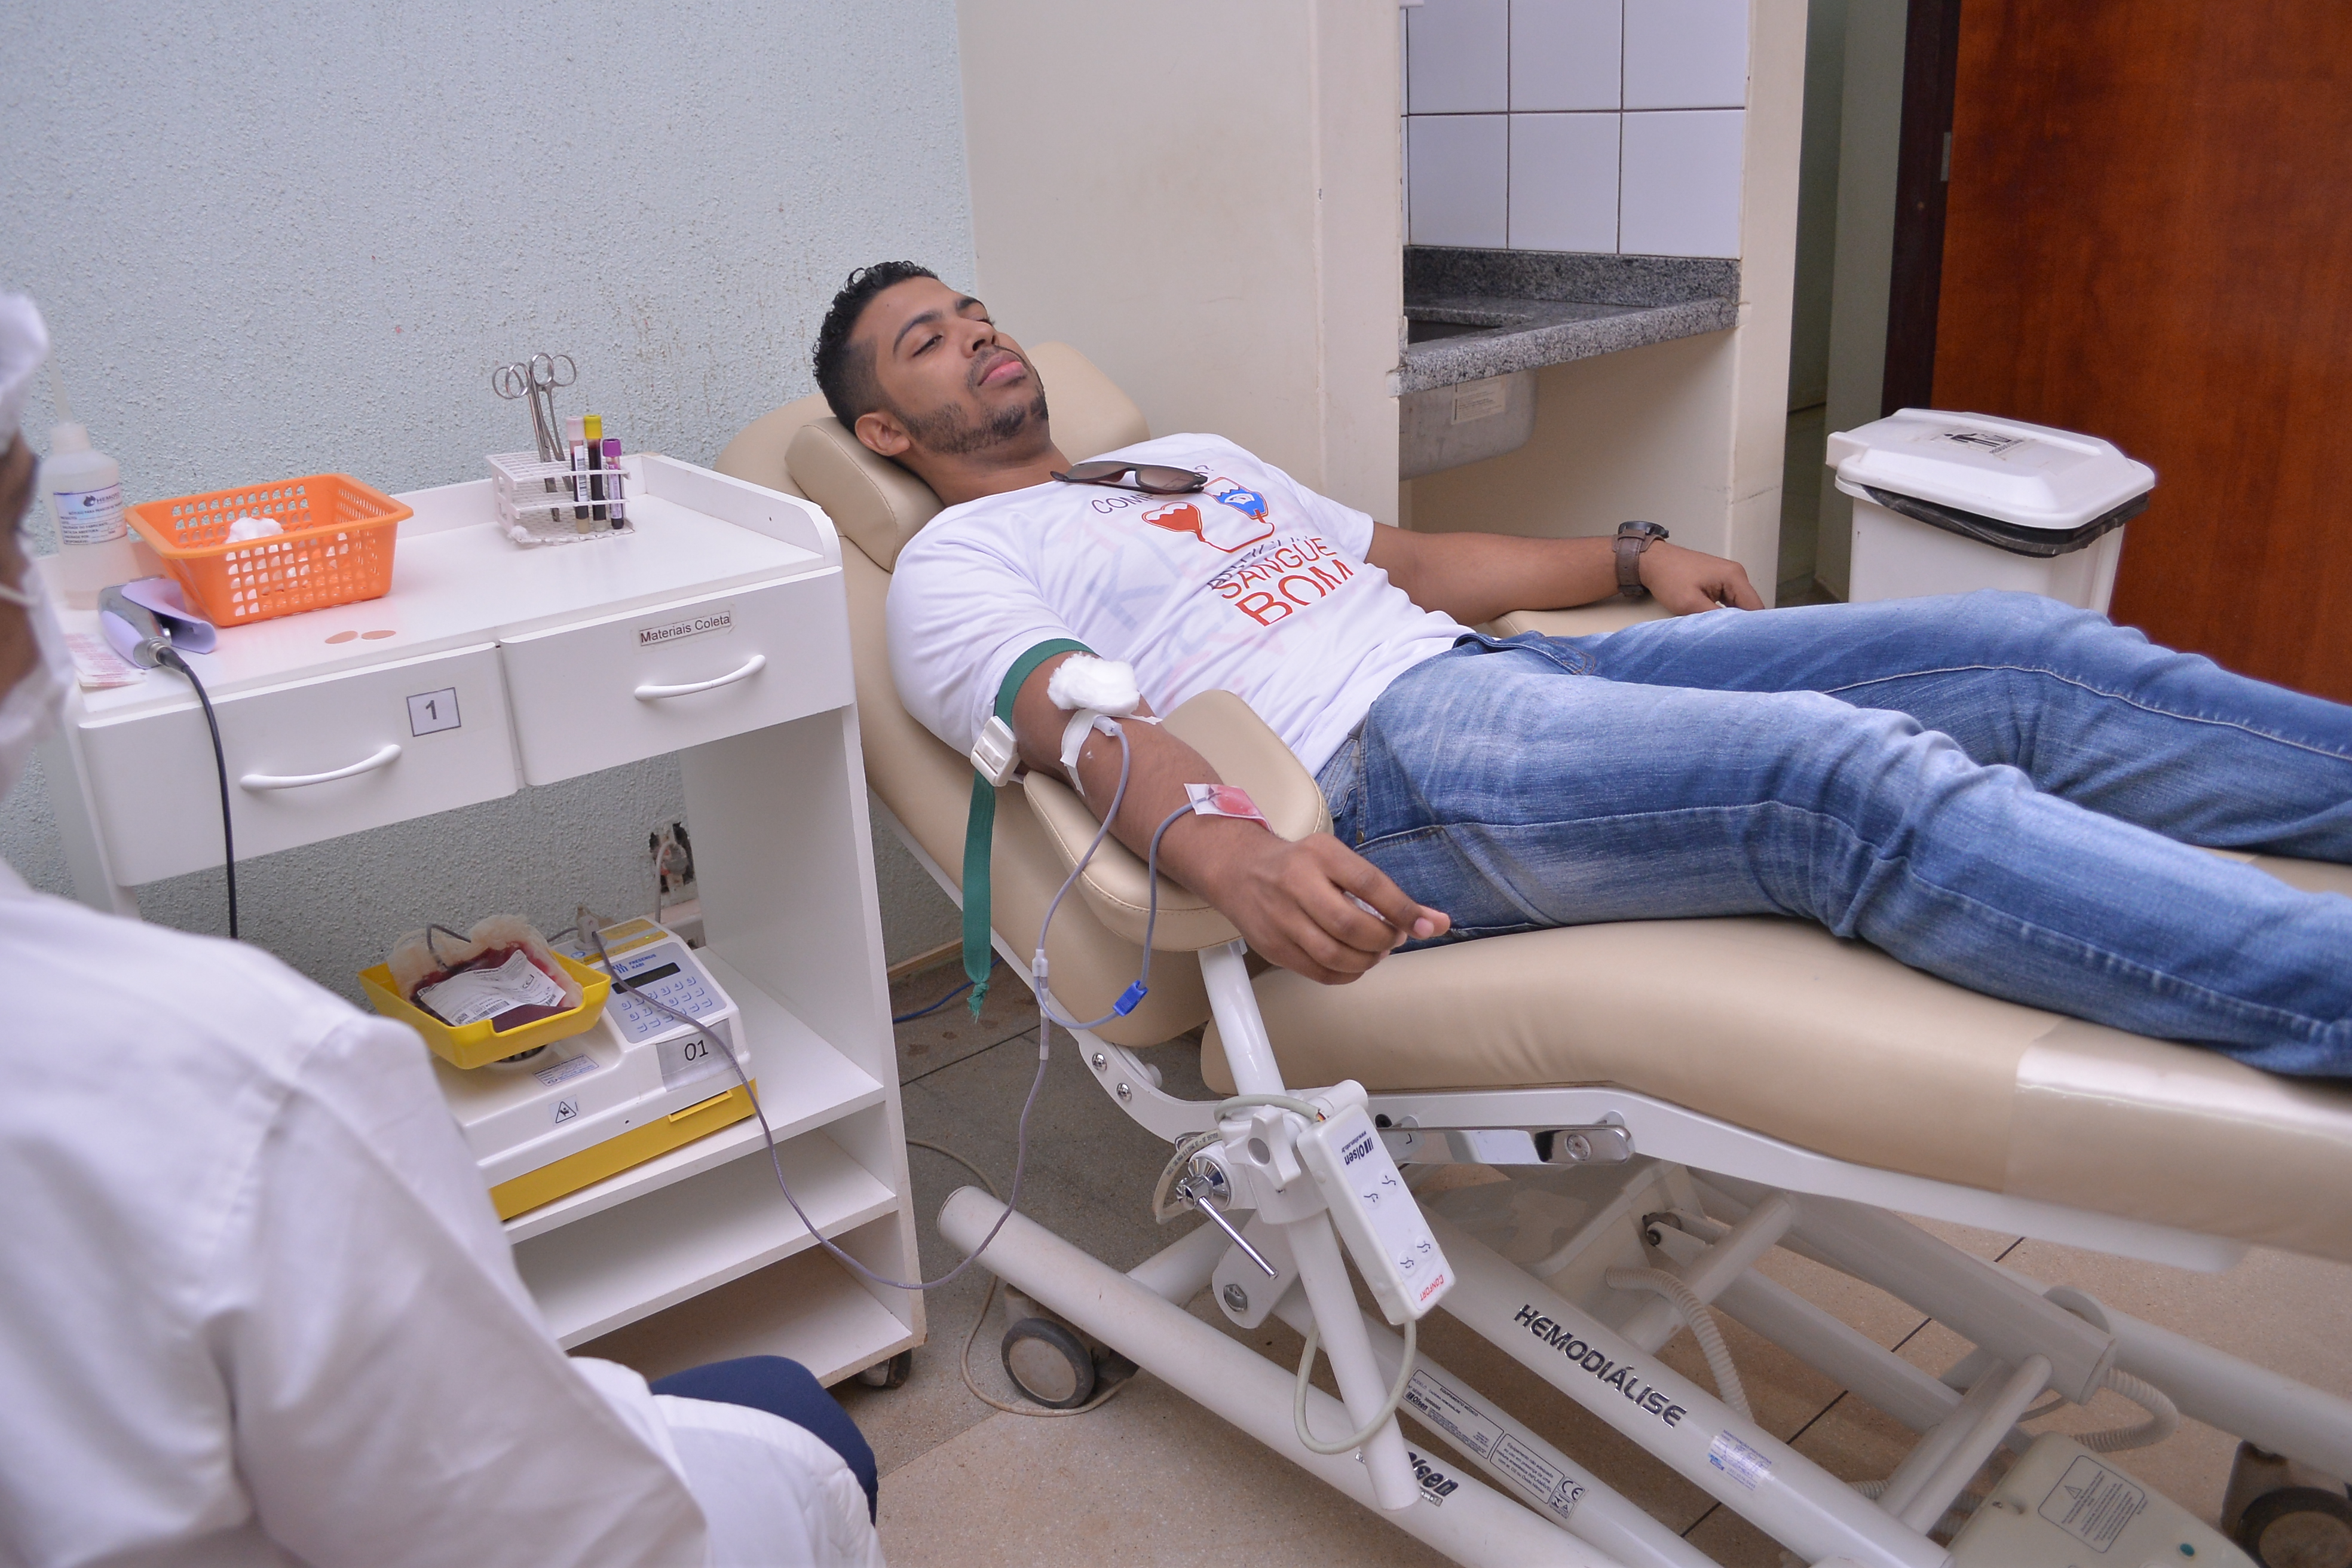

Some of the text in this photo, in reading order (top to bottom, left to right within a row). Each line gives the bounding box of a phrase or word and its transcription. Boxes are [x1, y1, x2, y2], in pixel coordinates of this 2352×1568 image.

[1215, 537, 1337, 599] SANGUE
[1235, 559, 1354, 627] BOM
[641, 616, 730, 643] Materiais Coleta
[425, 700, 437, 719] 1
[629, 954, 656, 966] FRESENIUS
[684, 1039, 709, 1061] 01
[1344, 1144, 1365, 1166] Olsen
[1420, 1274, 1444, 1301] CONFORT
[1513, 1304, 1688, 1429] HEMODIÁLISE
[1411, 1395, 1429, 1411] Olsen
[1439, 1387, 1465, 1407] EQUIPAMENTO
[1506, 1442, 1530, 1461] Equipamento
[1535, 1463, 1554, 1479] adequado
[1521, 1460, 1538, 1474] presença
[1527, 1472, 1553, 1492] INFLAMÁVEL
